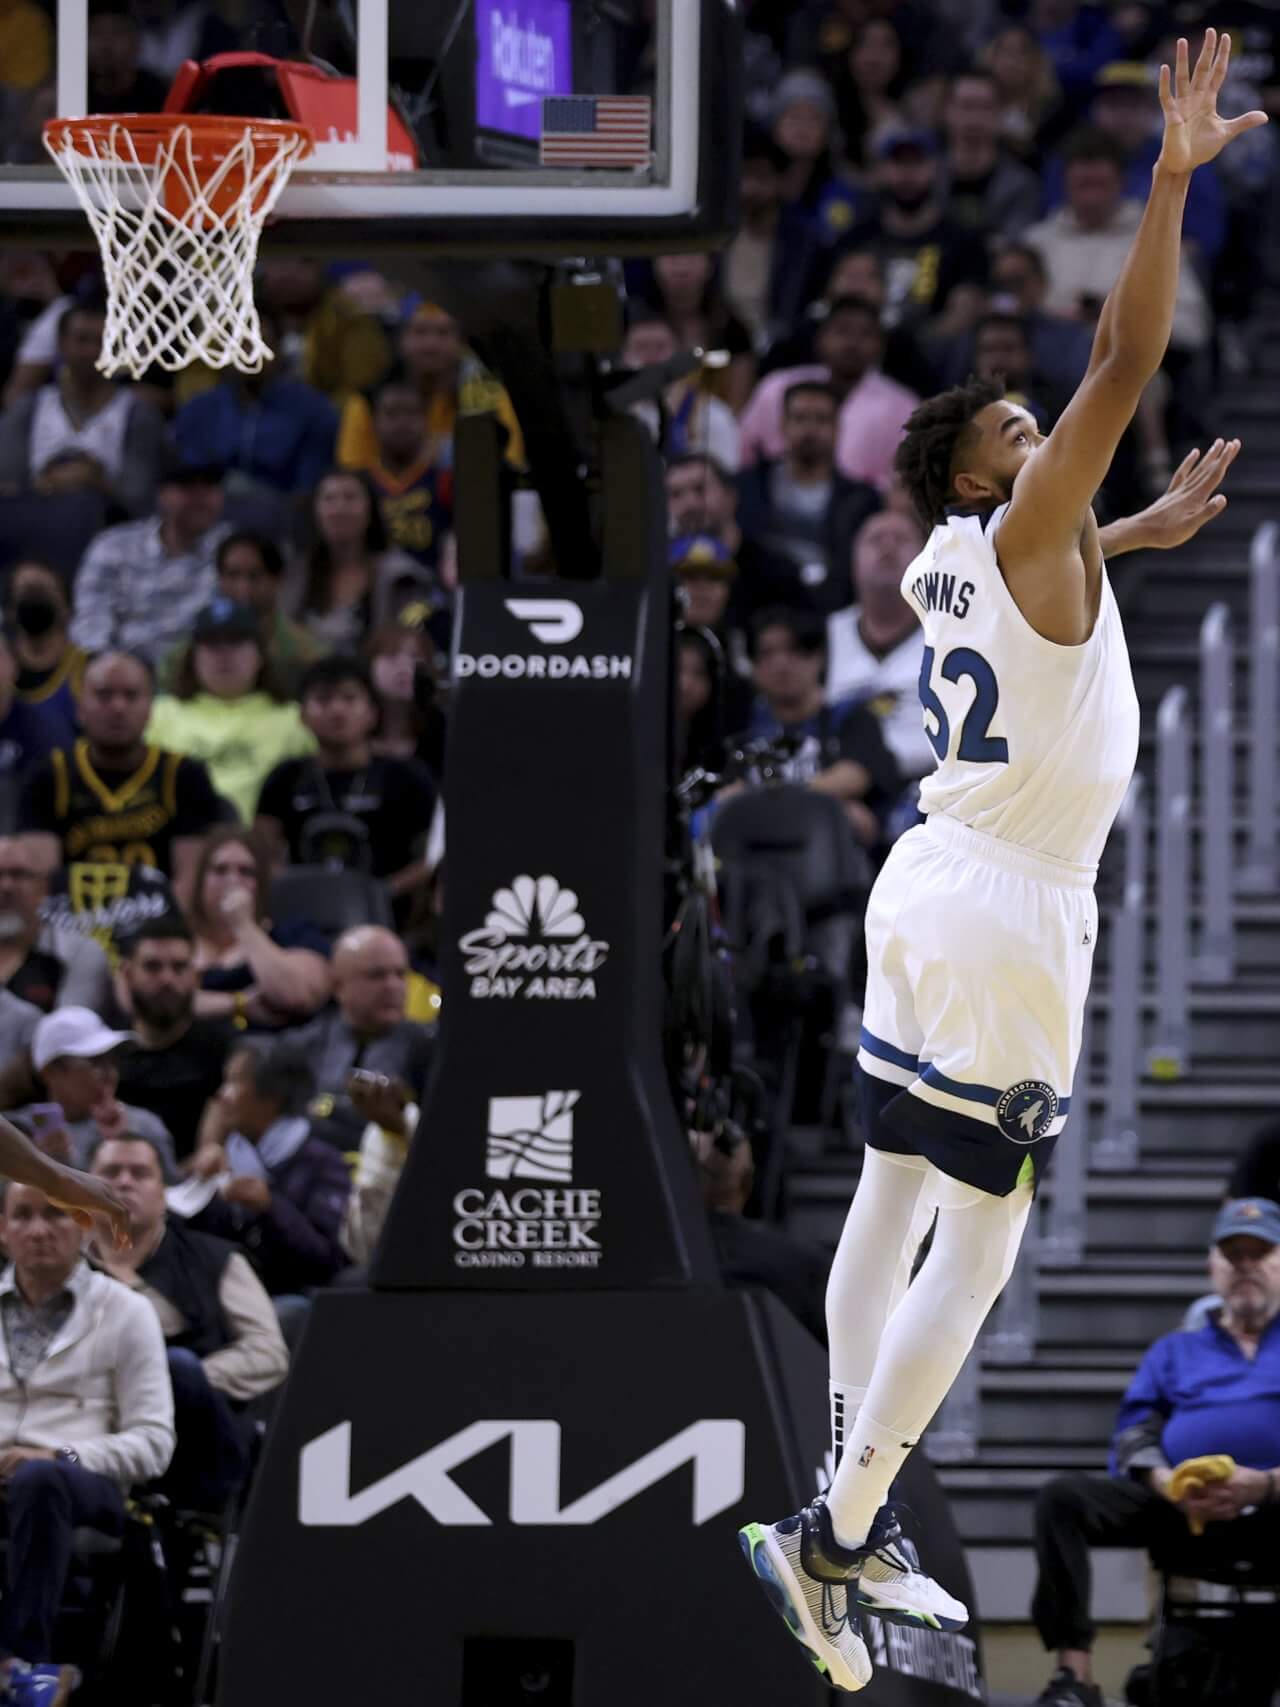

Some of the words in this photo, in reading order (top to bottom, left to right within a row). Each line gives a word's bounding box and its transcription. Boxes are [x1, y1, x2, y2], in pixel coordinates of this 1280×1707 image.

[491, 9, 555, 93] Rakuten
[912, 572, 975, 619] TOWNS
[455, 653, 632, 679] DOORDASH
[458, 927, 609, 979] Sports
[470, 976, 523, 998] BAY
[525, 977, 596, 999] AREA
[453, 1188, 601, 1219] CACHE
[453, 1218, 601, 1249] CREEK
[455, 1251, 525, 1267] CASINO
[532, 1251, 602, 1267] RESORT
